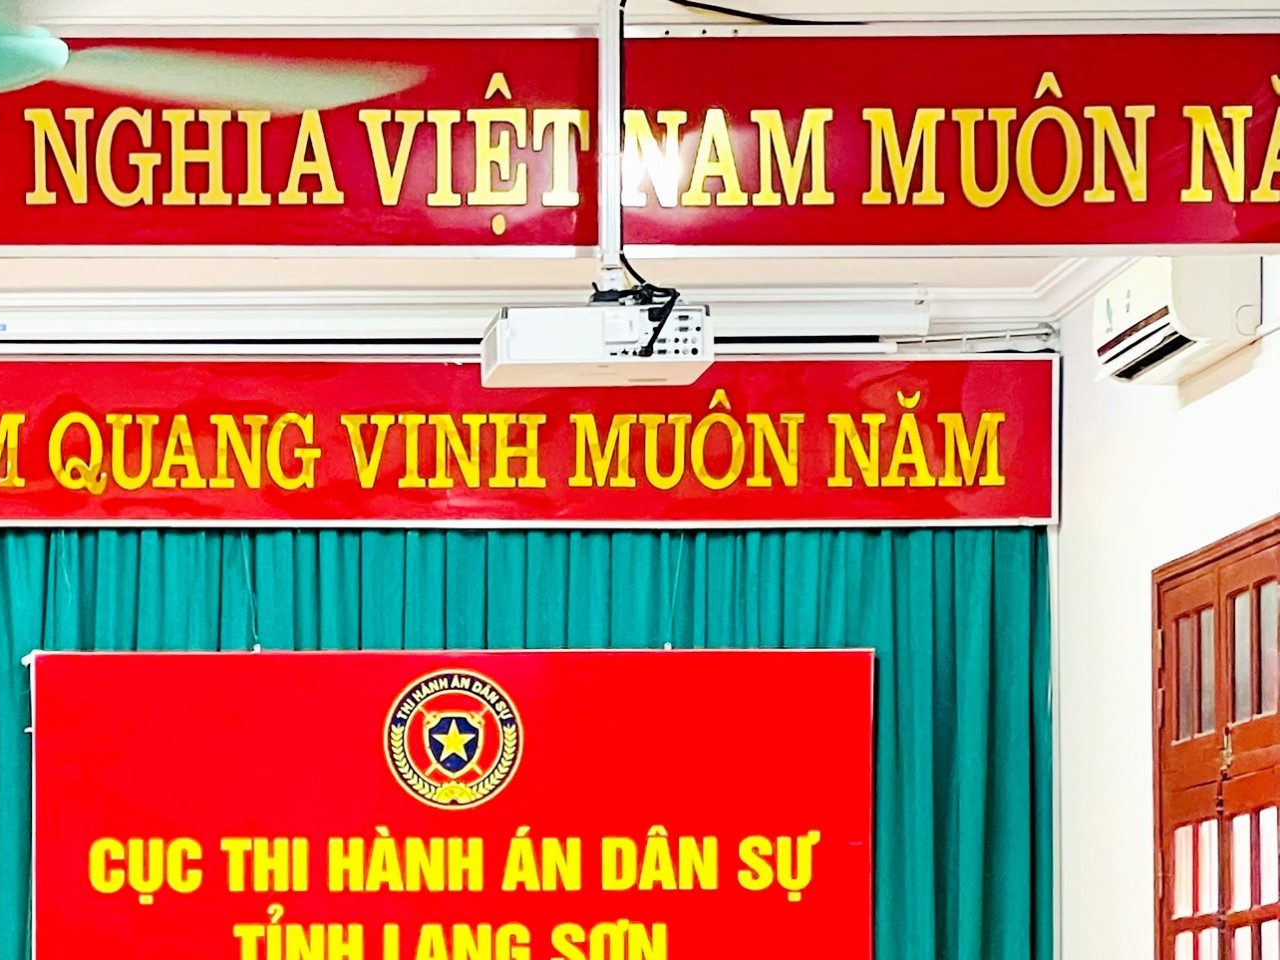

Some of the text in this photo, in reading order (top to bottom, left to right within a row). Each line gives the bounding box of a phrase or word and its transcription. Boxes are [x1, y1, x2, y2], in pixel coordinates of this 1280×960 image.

[360, 72, 590, 236] VIỆT
[621, 107, 835, 208] NAM
[862, 71, 1156, 209] MUÔN
[48, 411, 322, 495] QUANG
[340, 412, 548, 490] VINH
[567, 388, 805, 491] MUÔN
[827, 390, 1006, 488] NĂM
[396, 698, 416, 720] THI
[88, 824, 821, 905] CỤC THI HÀNH ÁN DÂN SỰ
